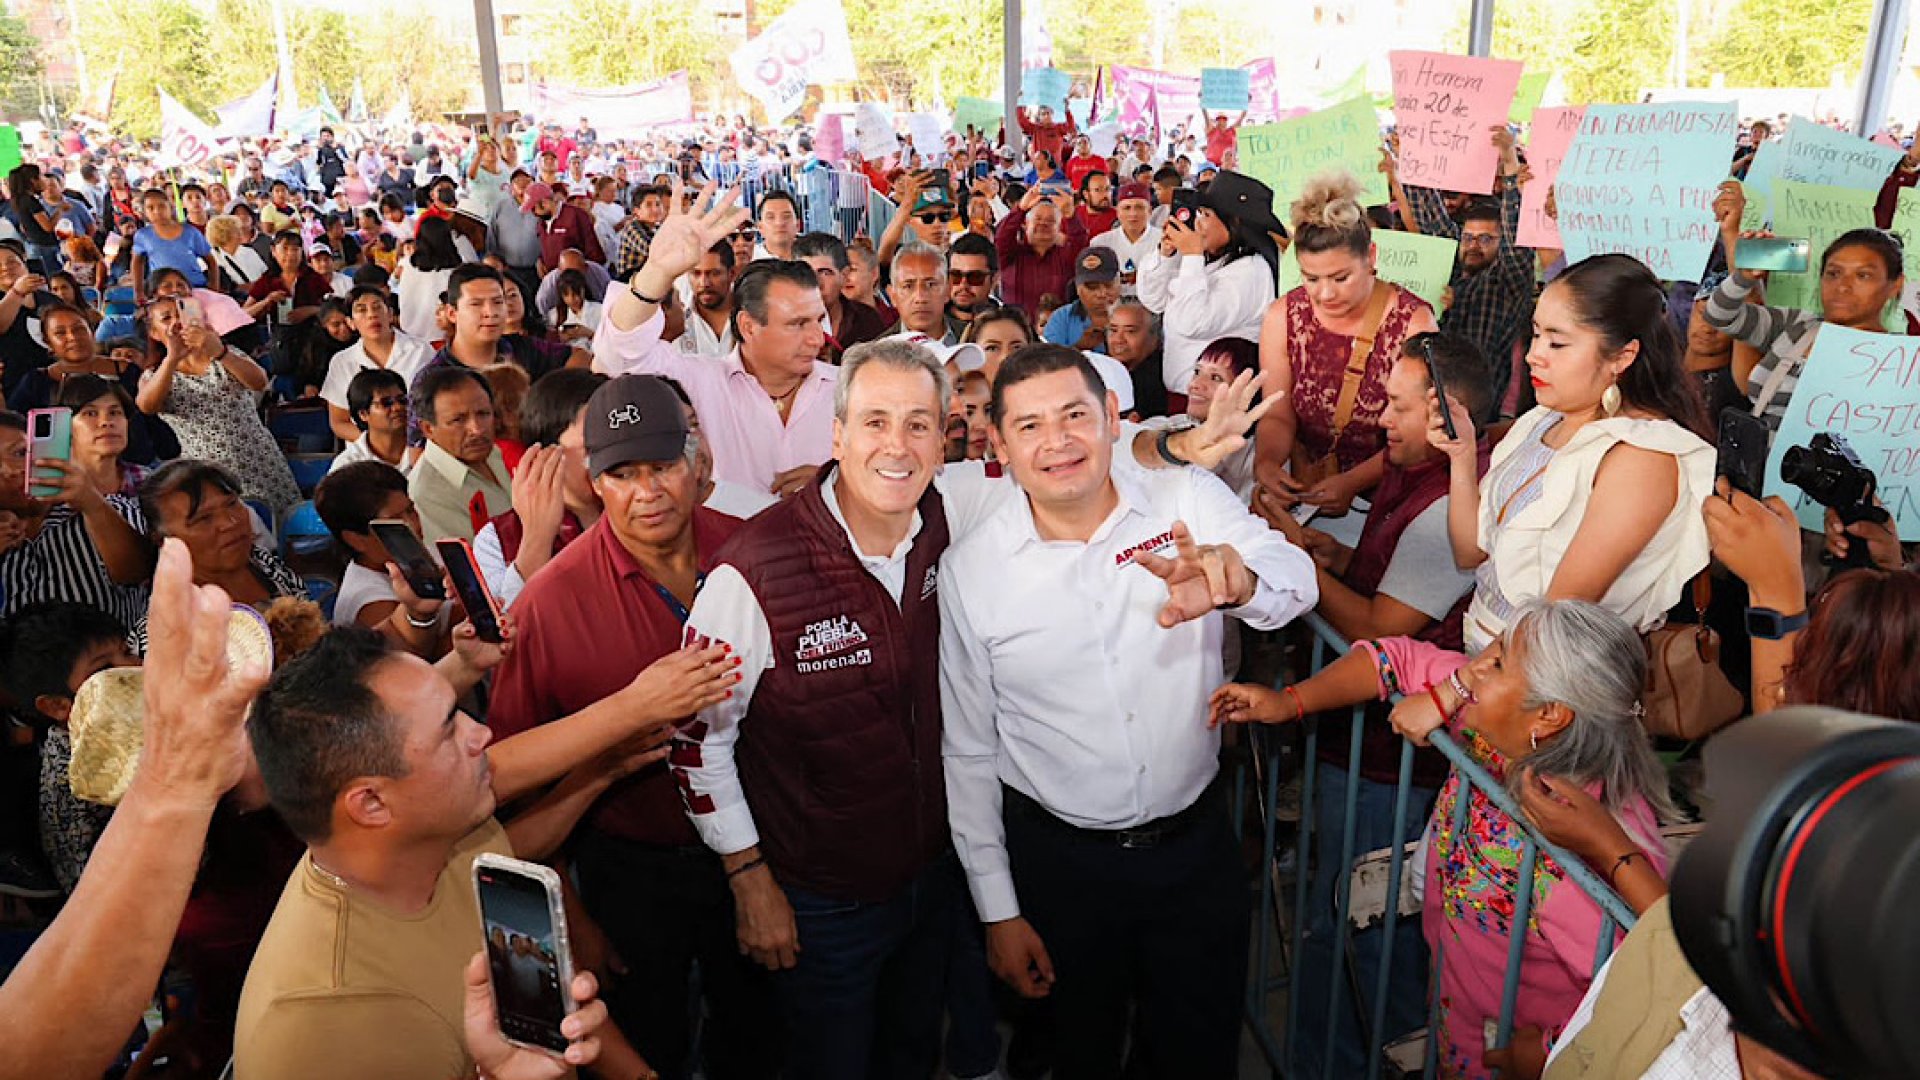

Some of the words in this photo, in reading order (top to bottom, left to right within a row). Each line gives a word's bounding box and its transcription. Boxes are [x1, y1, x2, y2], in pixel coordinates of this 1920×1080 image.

[1424, 91, 1451, 113] 20
[1785, 188, 1871, 220] ARMENT
[805, 619, 831, 635] POR
[832, 614, 849, 629] LA
[800, 621, 862, 651] PUEBLA
[797, 653, 857, 673] morena
